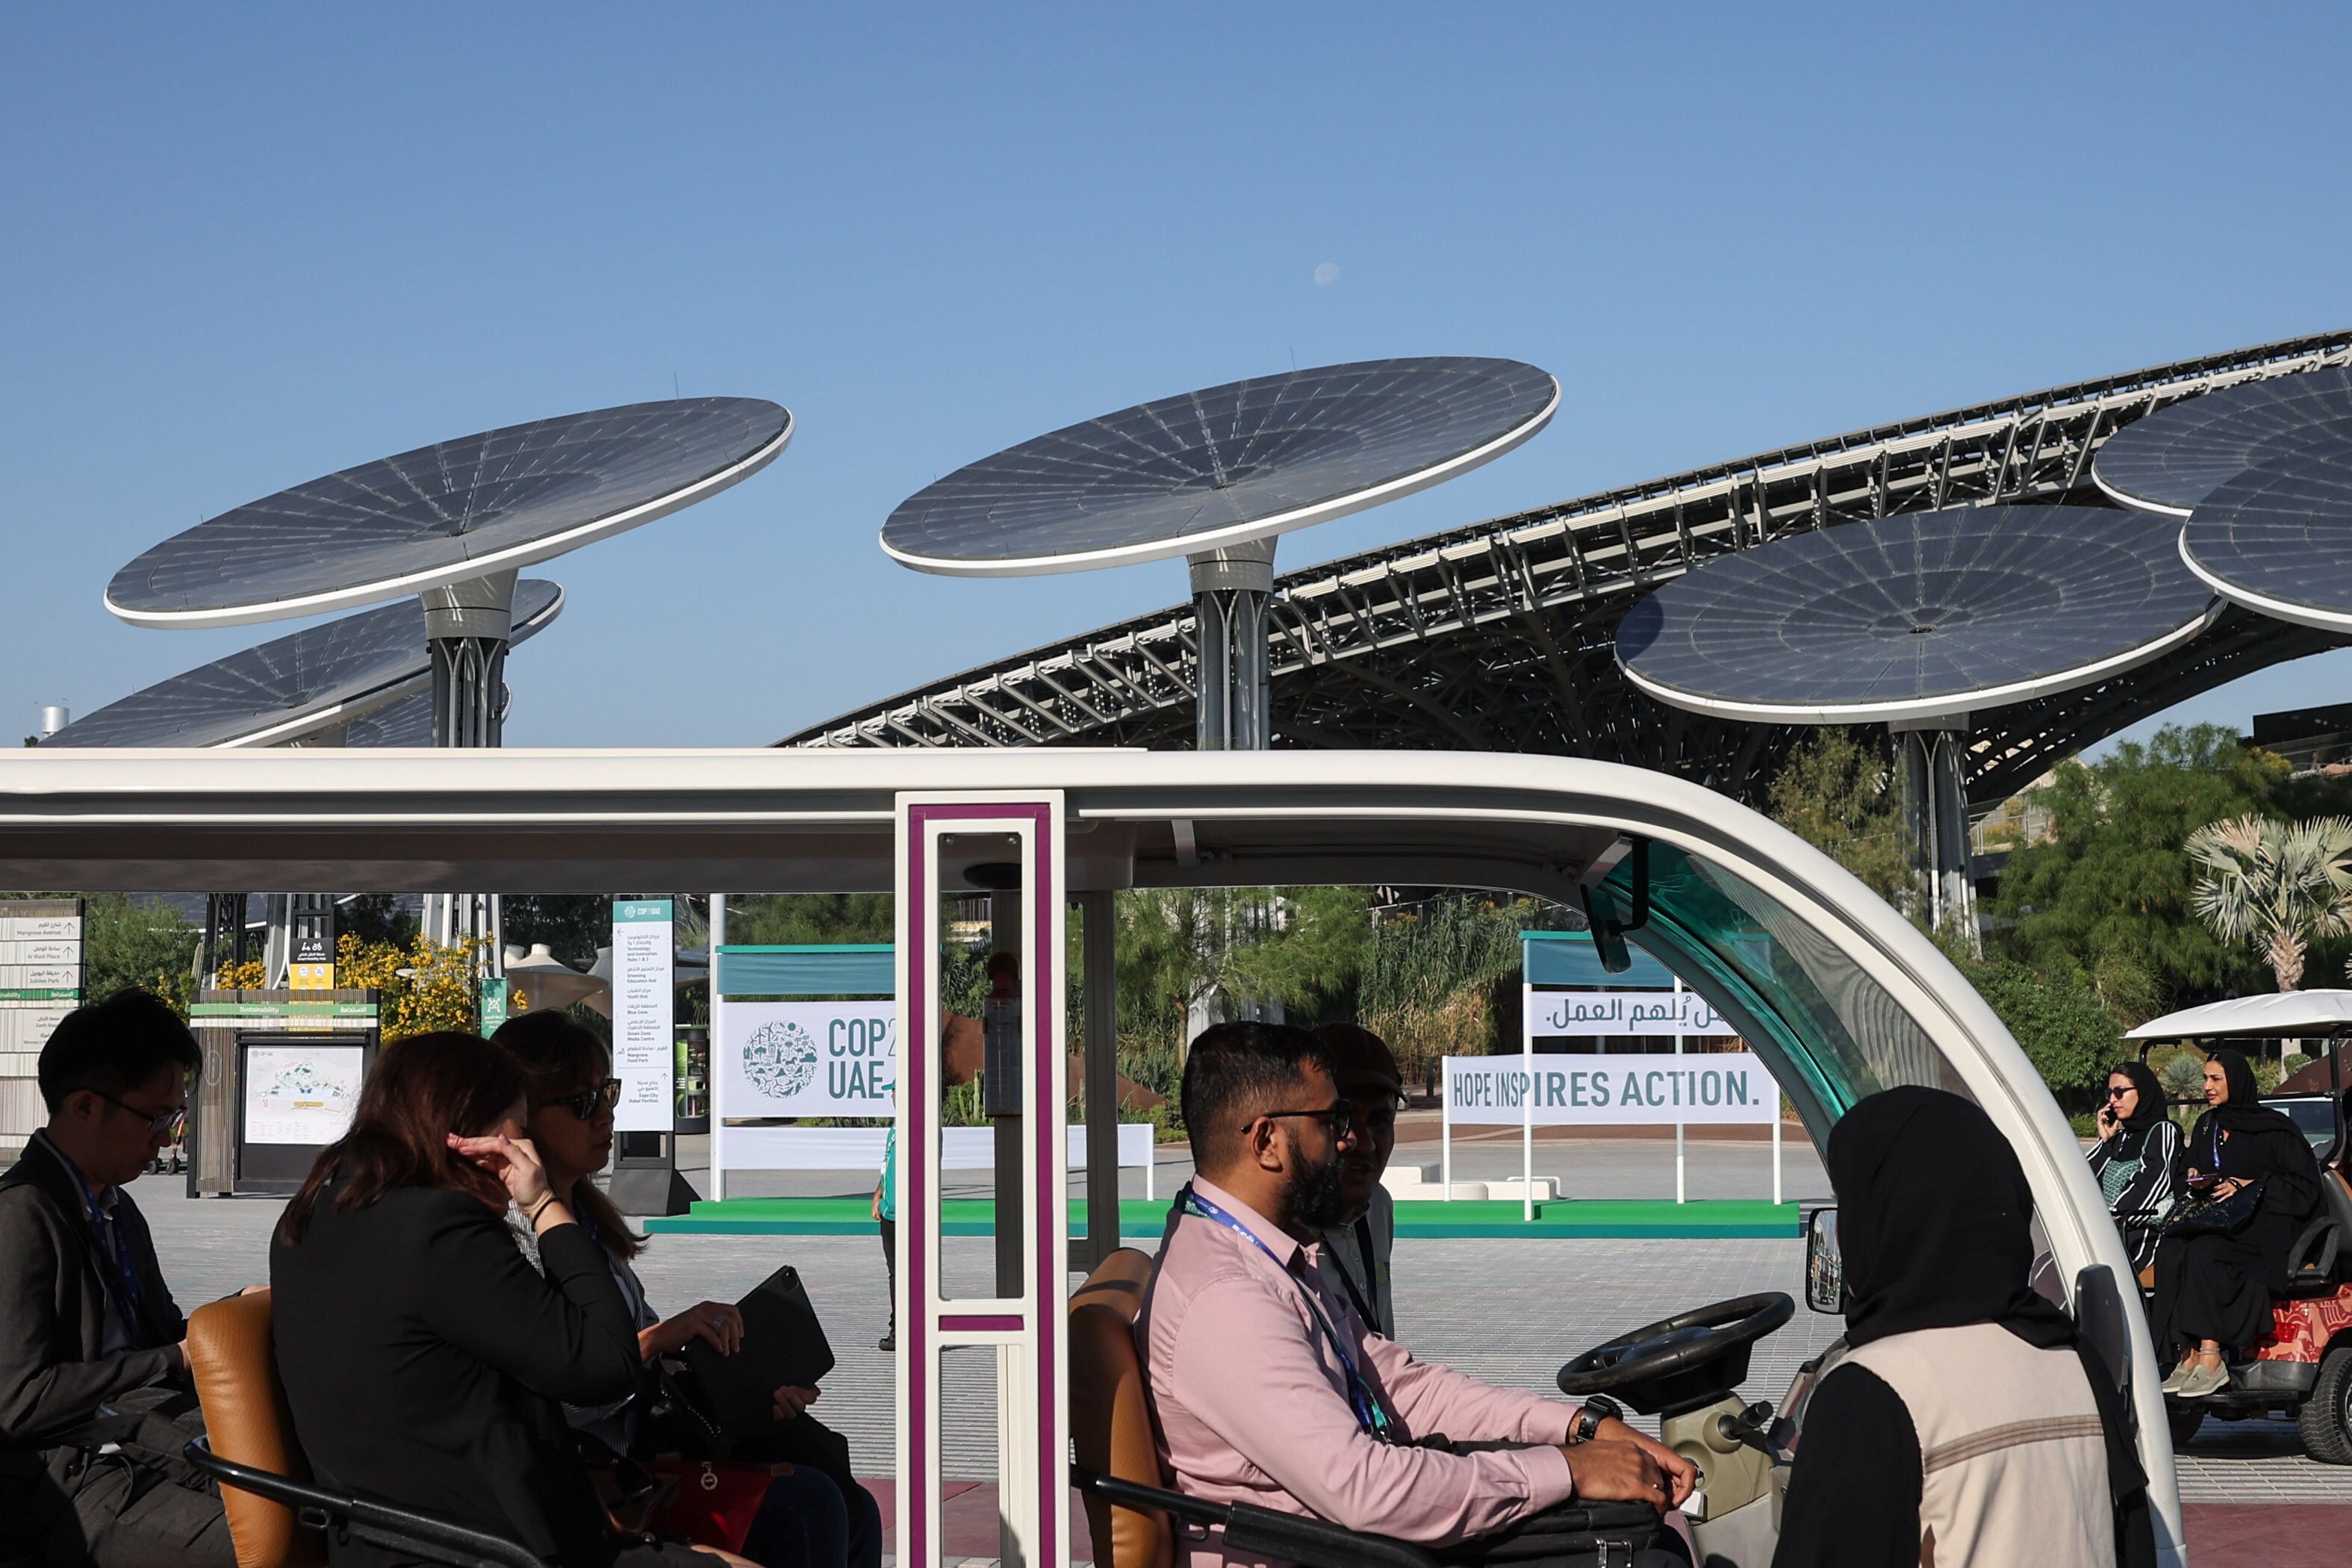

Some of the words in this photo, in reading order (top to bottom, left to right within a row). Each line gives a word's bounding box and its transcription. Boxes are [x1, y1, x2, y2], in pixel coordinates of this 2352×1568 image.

[239, 1007, 279, 1015] Sustainability
[1546, 998, 1623, 1030] العمل.
[829, 1061, 884, 1098] UAE
[1454, 1073, 1491, 1107] HOPE
[1496, 1071, 1610, 1107] INSPIRES
[1620, 1071, 1759, 1106] ACTION.
